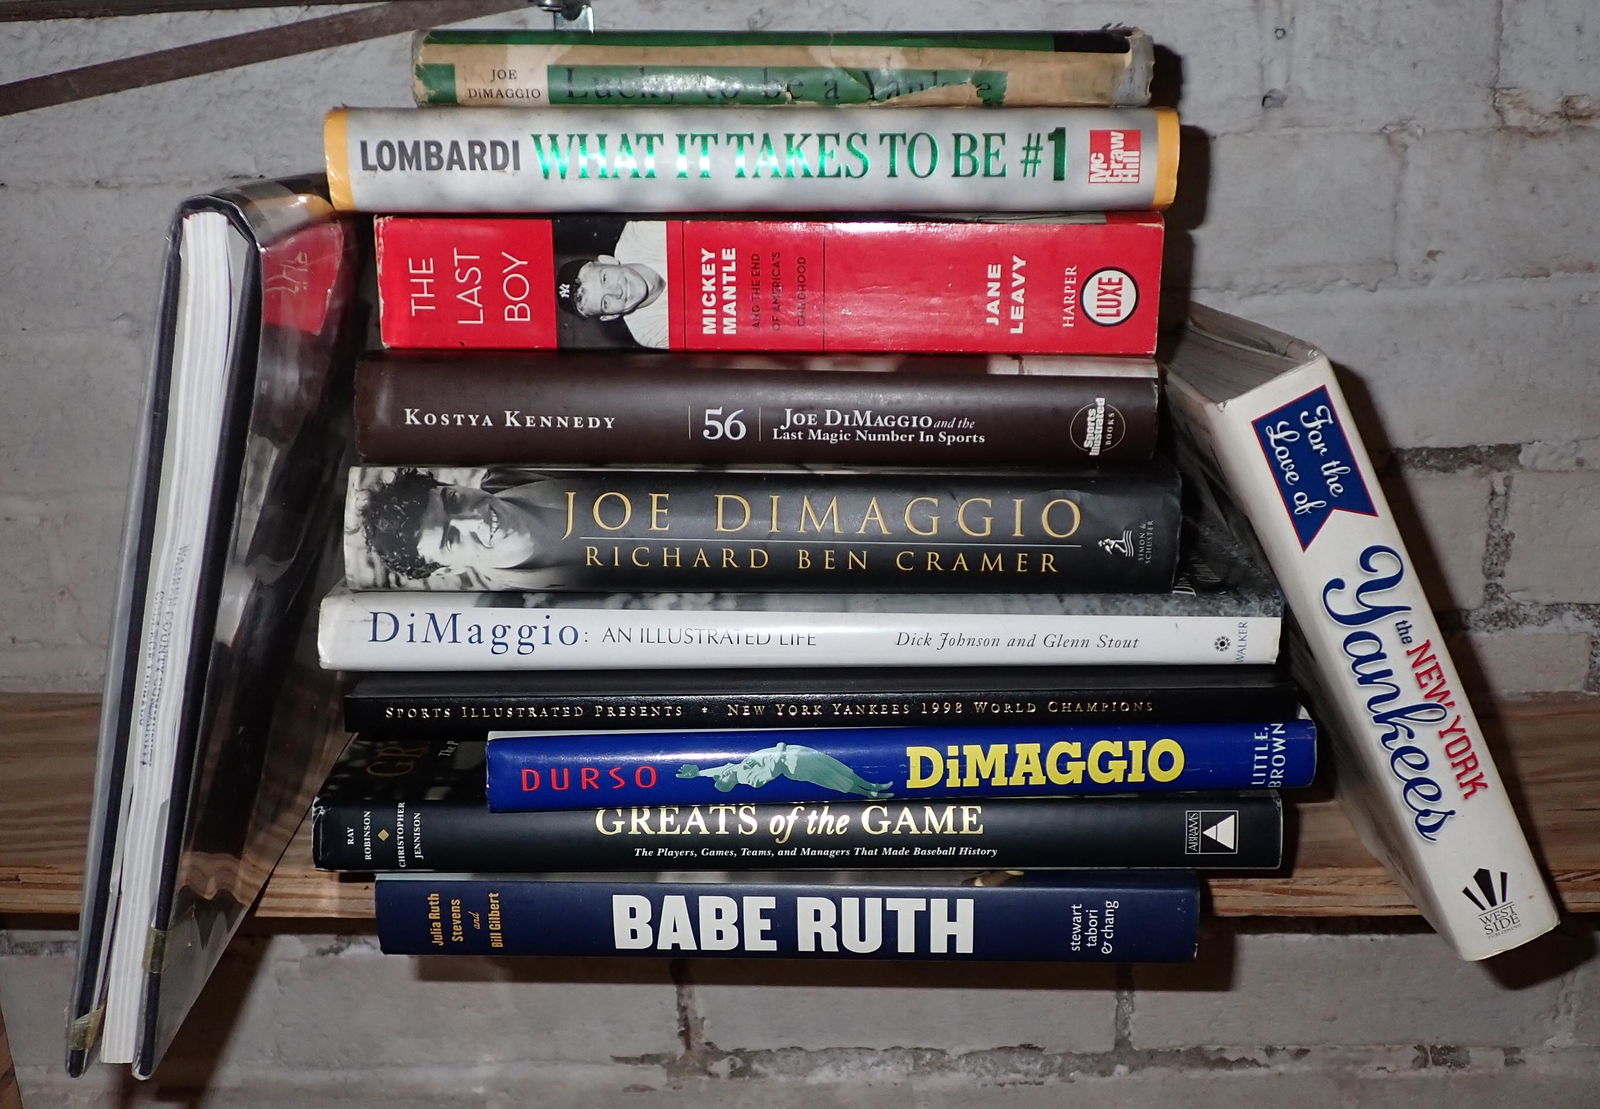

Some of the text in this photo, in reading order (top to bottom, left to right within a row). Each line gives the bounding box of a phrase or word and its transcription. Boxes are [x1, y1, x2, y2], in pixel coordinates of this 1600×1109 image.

[490, 69, 517, 82] JOE
[566, 67, 682, 103] Luck
[763, 67, 804, 99] be
[824, 78, 840, 99] a
[360, 127, 1067, 181] LOMBARDI WHAT IT TAKES TO BE #1
[1090, 152, 1108, 182] Mc
[1105, 131, 1125, 182] Graw
[1120, 150, 1140, 181] Hill
[407, 257, 436, 317] THE
[453, 248, 484, 326] LAST
[501, 251, 532, 322] BOY
[701, 248, 717, 335] MICKEY
[722, 248, 737, 335] MANTLE
[751, 253, 761, 328] AND THE END
[771, 251, 781, 331] OF AMERICA'S
[797, 256, 807, 327] CHILDHOOD
[985, 263, 1003, 327] JANE
[1010, 255, 1028, 335] LEAVY
[1062, 265, 1077, 328] HARPER
[1096, 276, 1124, 319] LUXE
[404, 408, 617, 431] KOSTYA KENNEDY
[702, 405, 747, 441] 56
[772, 428, 986, 446] Last Magic Number In Sports
[780, 408, 818, 430] JOE
[933, 418, 955, 429] and
[957, 417, 976, 429] the
[1083, 408, 1096, 448] Sports
[1089, 397, 1106, 456] Illustrated
[1105, 412, 1115, 445] BOOKS
[1265, 421, 1327, 515] Love of
[1300, 405, 1351, 497] For the
[560, 491, 1082, 541] JOE DIMAGGIO
[585, 546, 1060, 574] RICHARD BEN CRAMER
[1137, 532, 1146, 561] SIMON
[1145, 519, 1154, 564] SCHUSTER
[368, 612, 589, 655] DiMaggio:
[602, 627, 633, 645] AN
[640, 626, 771, 645] ILLUSTRATED
[896, 631, 1140, 651] Dick Johnson and Glenn Stout
[1234, 621, 1249, 664] WALKER
[385, 701, 1154, 719] SPORTS ILLUSTRATED PRESENTS NEW YORK YANKEES 1998 WORLD CHAMPIONS
[1322, 544, 1457, 842] Yankees
[1395, 619, 1489, 800] the NEW YORK
[520, 765, 658, 793] DURSO
[905, 738, 1186, 789] DiMAGGIO
[1251, 726, 1270, 785] LITTLE,
[1267, 723, 1287, 788] BROWN
[346, 826, 355, 845] RAY
[363, 810, 373, 860] ROBINSON
[396, 801, 407, 868] CHRISTOPHER
[413, 812, 425, 860] JENNISON
[594, 805, 984, 844] GREATS of the GAME
[1188, 812, 1200, 852] ABRAMS
[634, 847, 998, 858] The Players, Games, Teams, and Managers That Made Baseball History
[427, 893, 444, 946] Julia Ruth
[451, 899, 464, 942] Stevens
[467, 911, 481, 930] and
[487, 892, 504, 948] Bill Gilbert
[612, 894, 975, 954] BABE RUTH
[1070, 903, 1082, 952] stewart
[1086, 909, 1099, 948] tabori
[1101, 900, 1120, 955] & chang
[1478, 903, 1515, 925] WEST
[1484, 913, 1521, 936] SIDE
